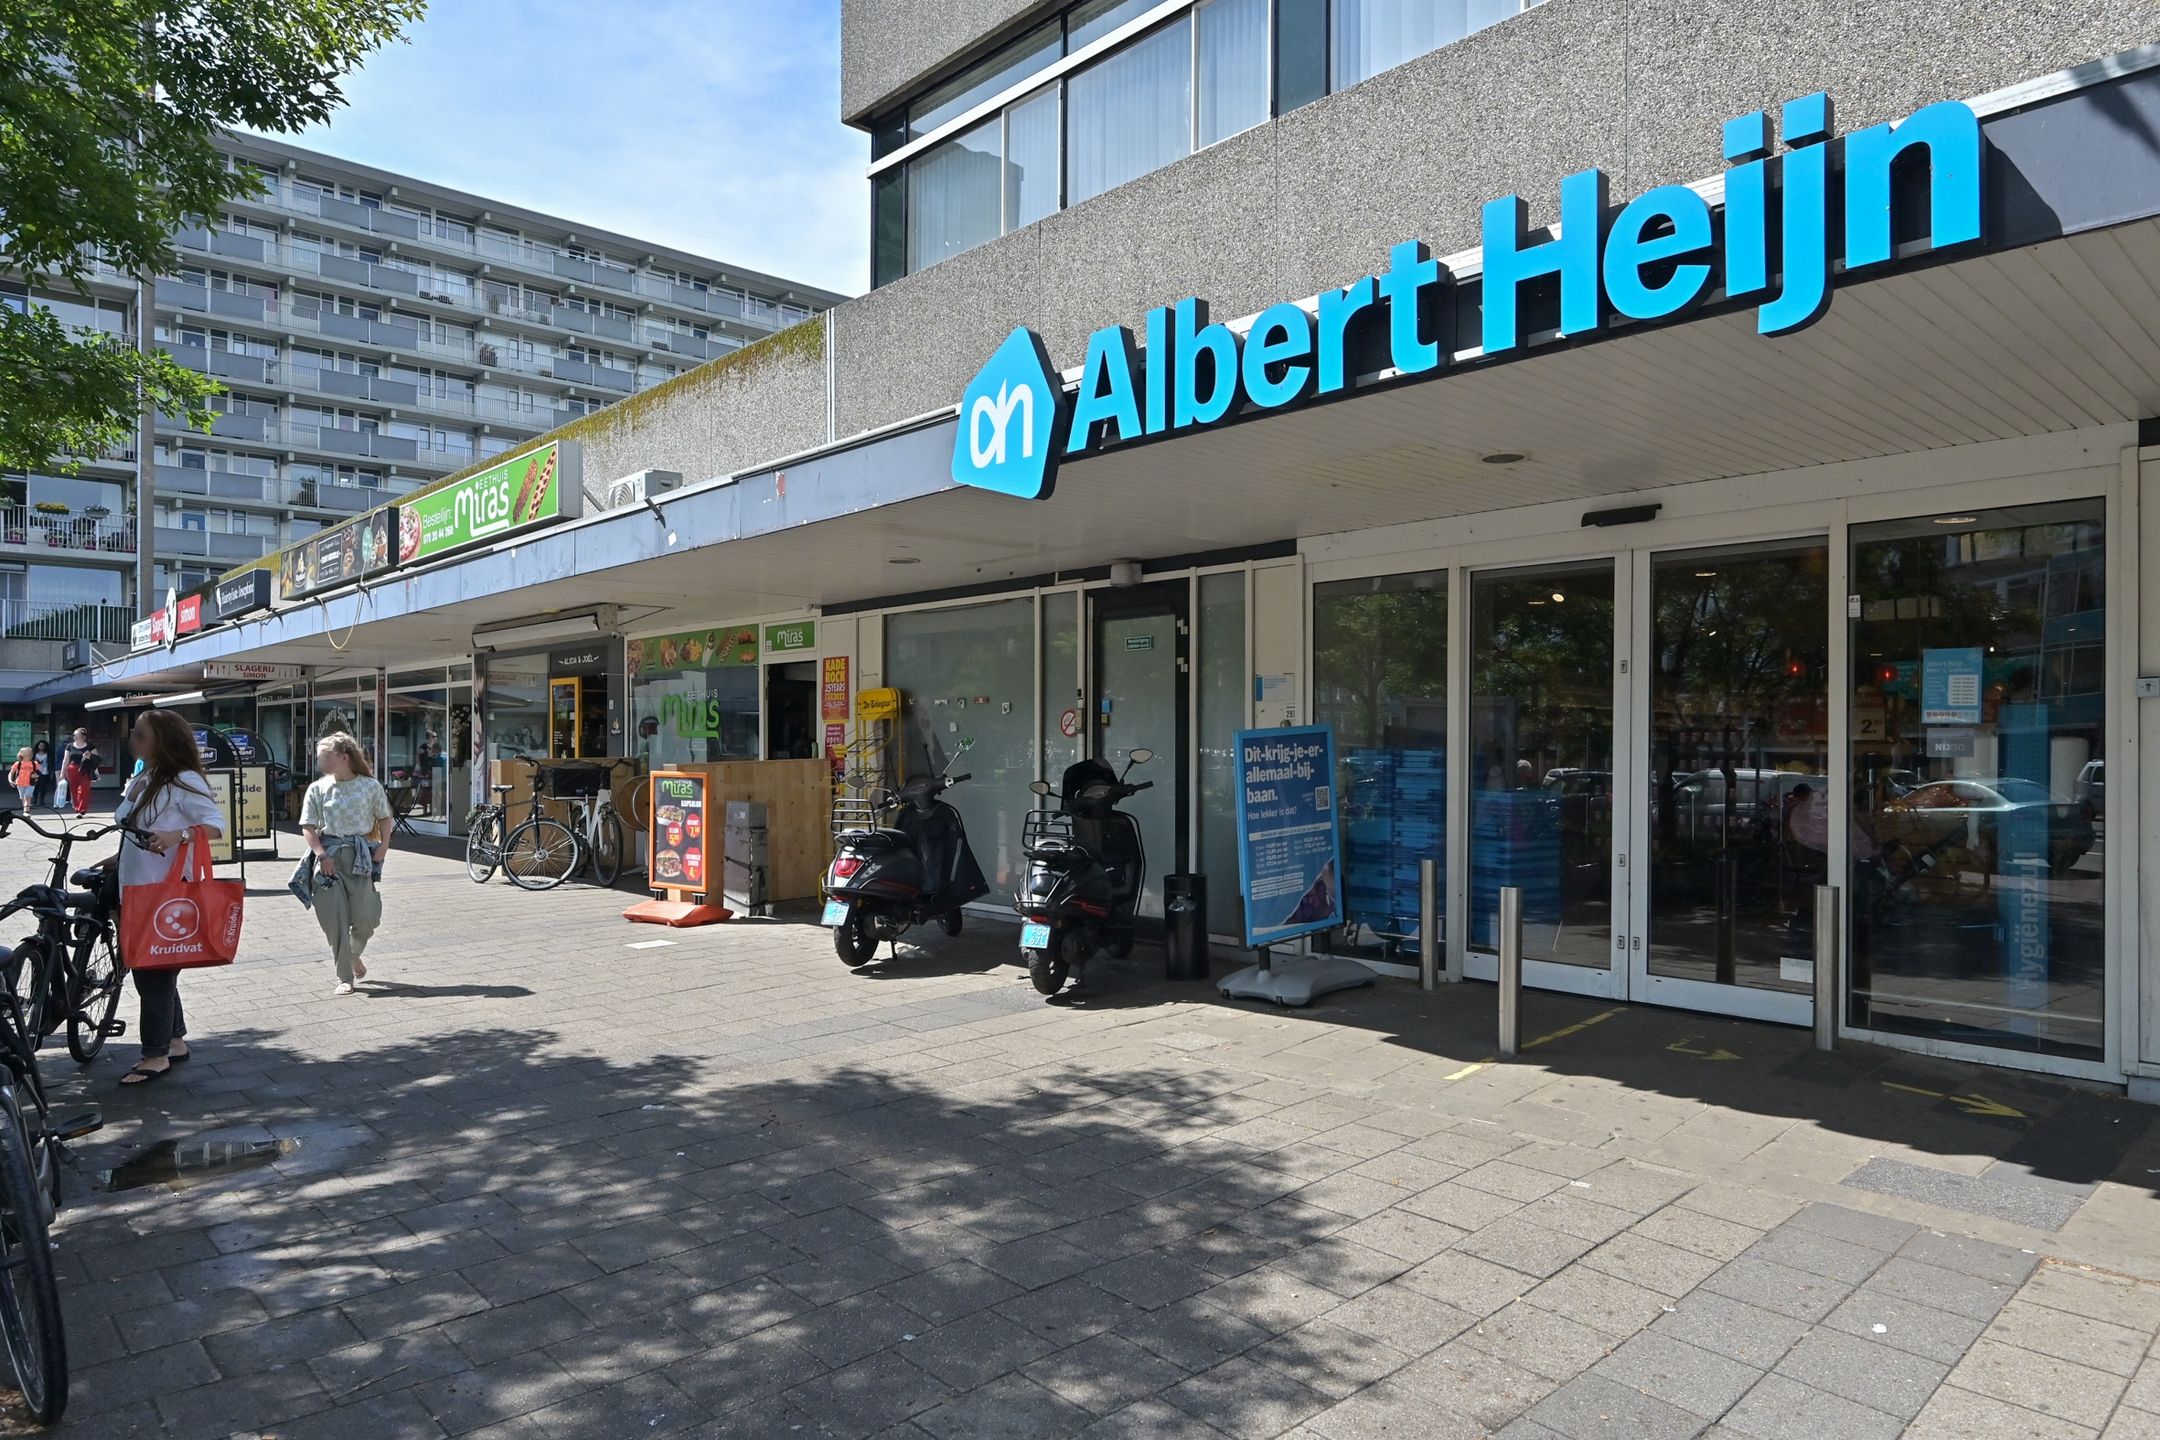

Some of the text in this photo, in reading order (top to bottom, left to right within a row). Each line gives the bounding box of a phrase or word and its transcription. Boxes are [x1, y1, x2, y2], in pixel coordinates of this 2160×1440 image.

[1066, 91, 1986, 453] Albert Heijn
[478, 468, 509, 490] EETHUIS
[180, 604, 196, 623] simon
[234, 664, 275, 673] SLAGERIJ
[825, 658, 846, 671] KADE
[825, 670, 846, 683] ROCK
[1244, 742, 1324, 763] Dit-krijg-je-er-
[1245, 761, 1315, 784] allemaal-bij-
[1246, 787, 1279, 804] baan.
[1247, 811, 1260, 820] Hoe
[1260, 808, 1279, 818] lekker
[1285, 806, 1297, 815] dat?
[227, 905, 241, 936] Kruidvat
[150, 942, 204, 956] Kruidvat
